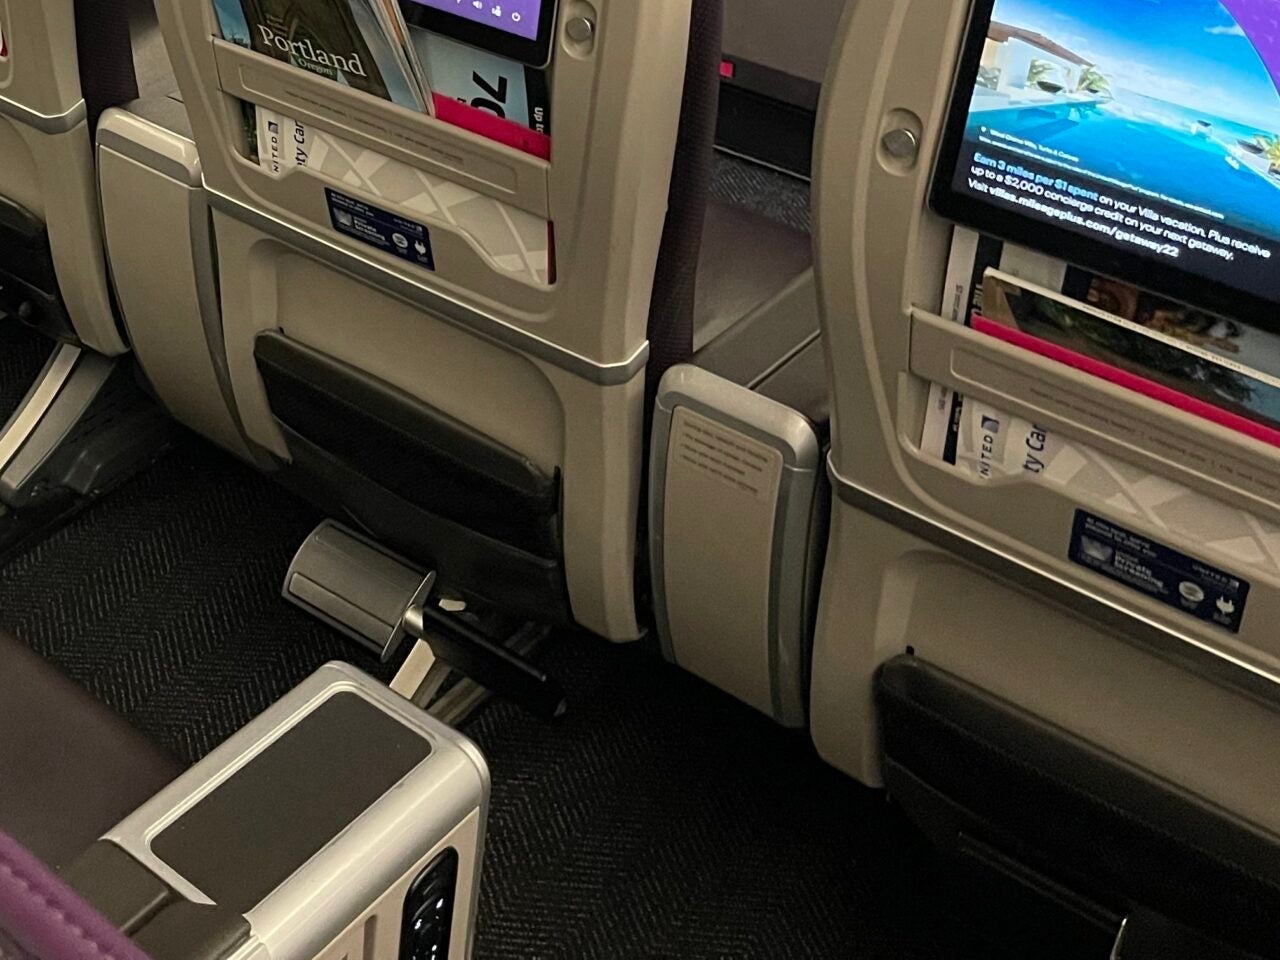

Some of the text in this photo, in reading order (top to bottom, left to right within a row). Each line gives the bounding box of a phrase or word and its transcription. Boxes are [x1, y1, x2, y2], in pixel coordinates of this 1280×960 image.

[256, 23, 367, 78] Portland
[271, 135, 279, 173] NITED
[294, 148, 308, 167] ty
[968, 177, 989, 193] Visit
[989, 186, 1179, 258] villas.mileageplus.com/getaway22
[971, 165, 1234, 261] up to a $2,000 concierge credit on your next getaway.
[973, 152, 997, 168] Earn
[997, 160, 1006, 171] 3
[1006, 164, 1035, 180] miles
[1035, 173, 1055, 186] per
[1054, 178, 1068, 191] $1
[1068, 184, 1100, 201] spent
[1099, 195, 1114, 207] on
[1114, 200, 1138, 214] your
[1138, 205, 1159, 222] Villa
[1208, 229, 1231, 246] Plus
[1231, 239, 1271, 259] receive
